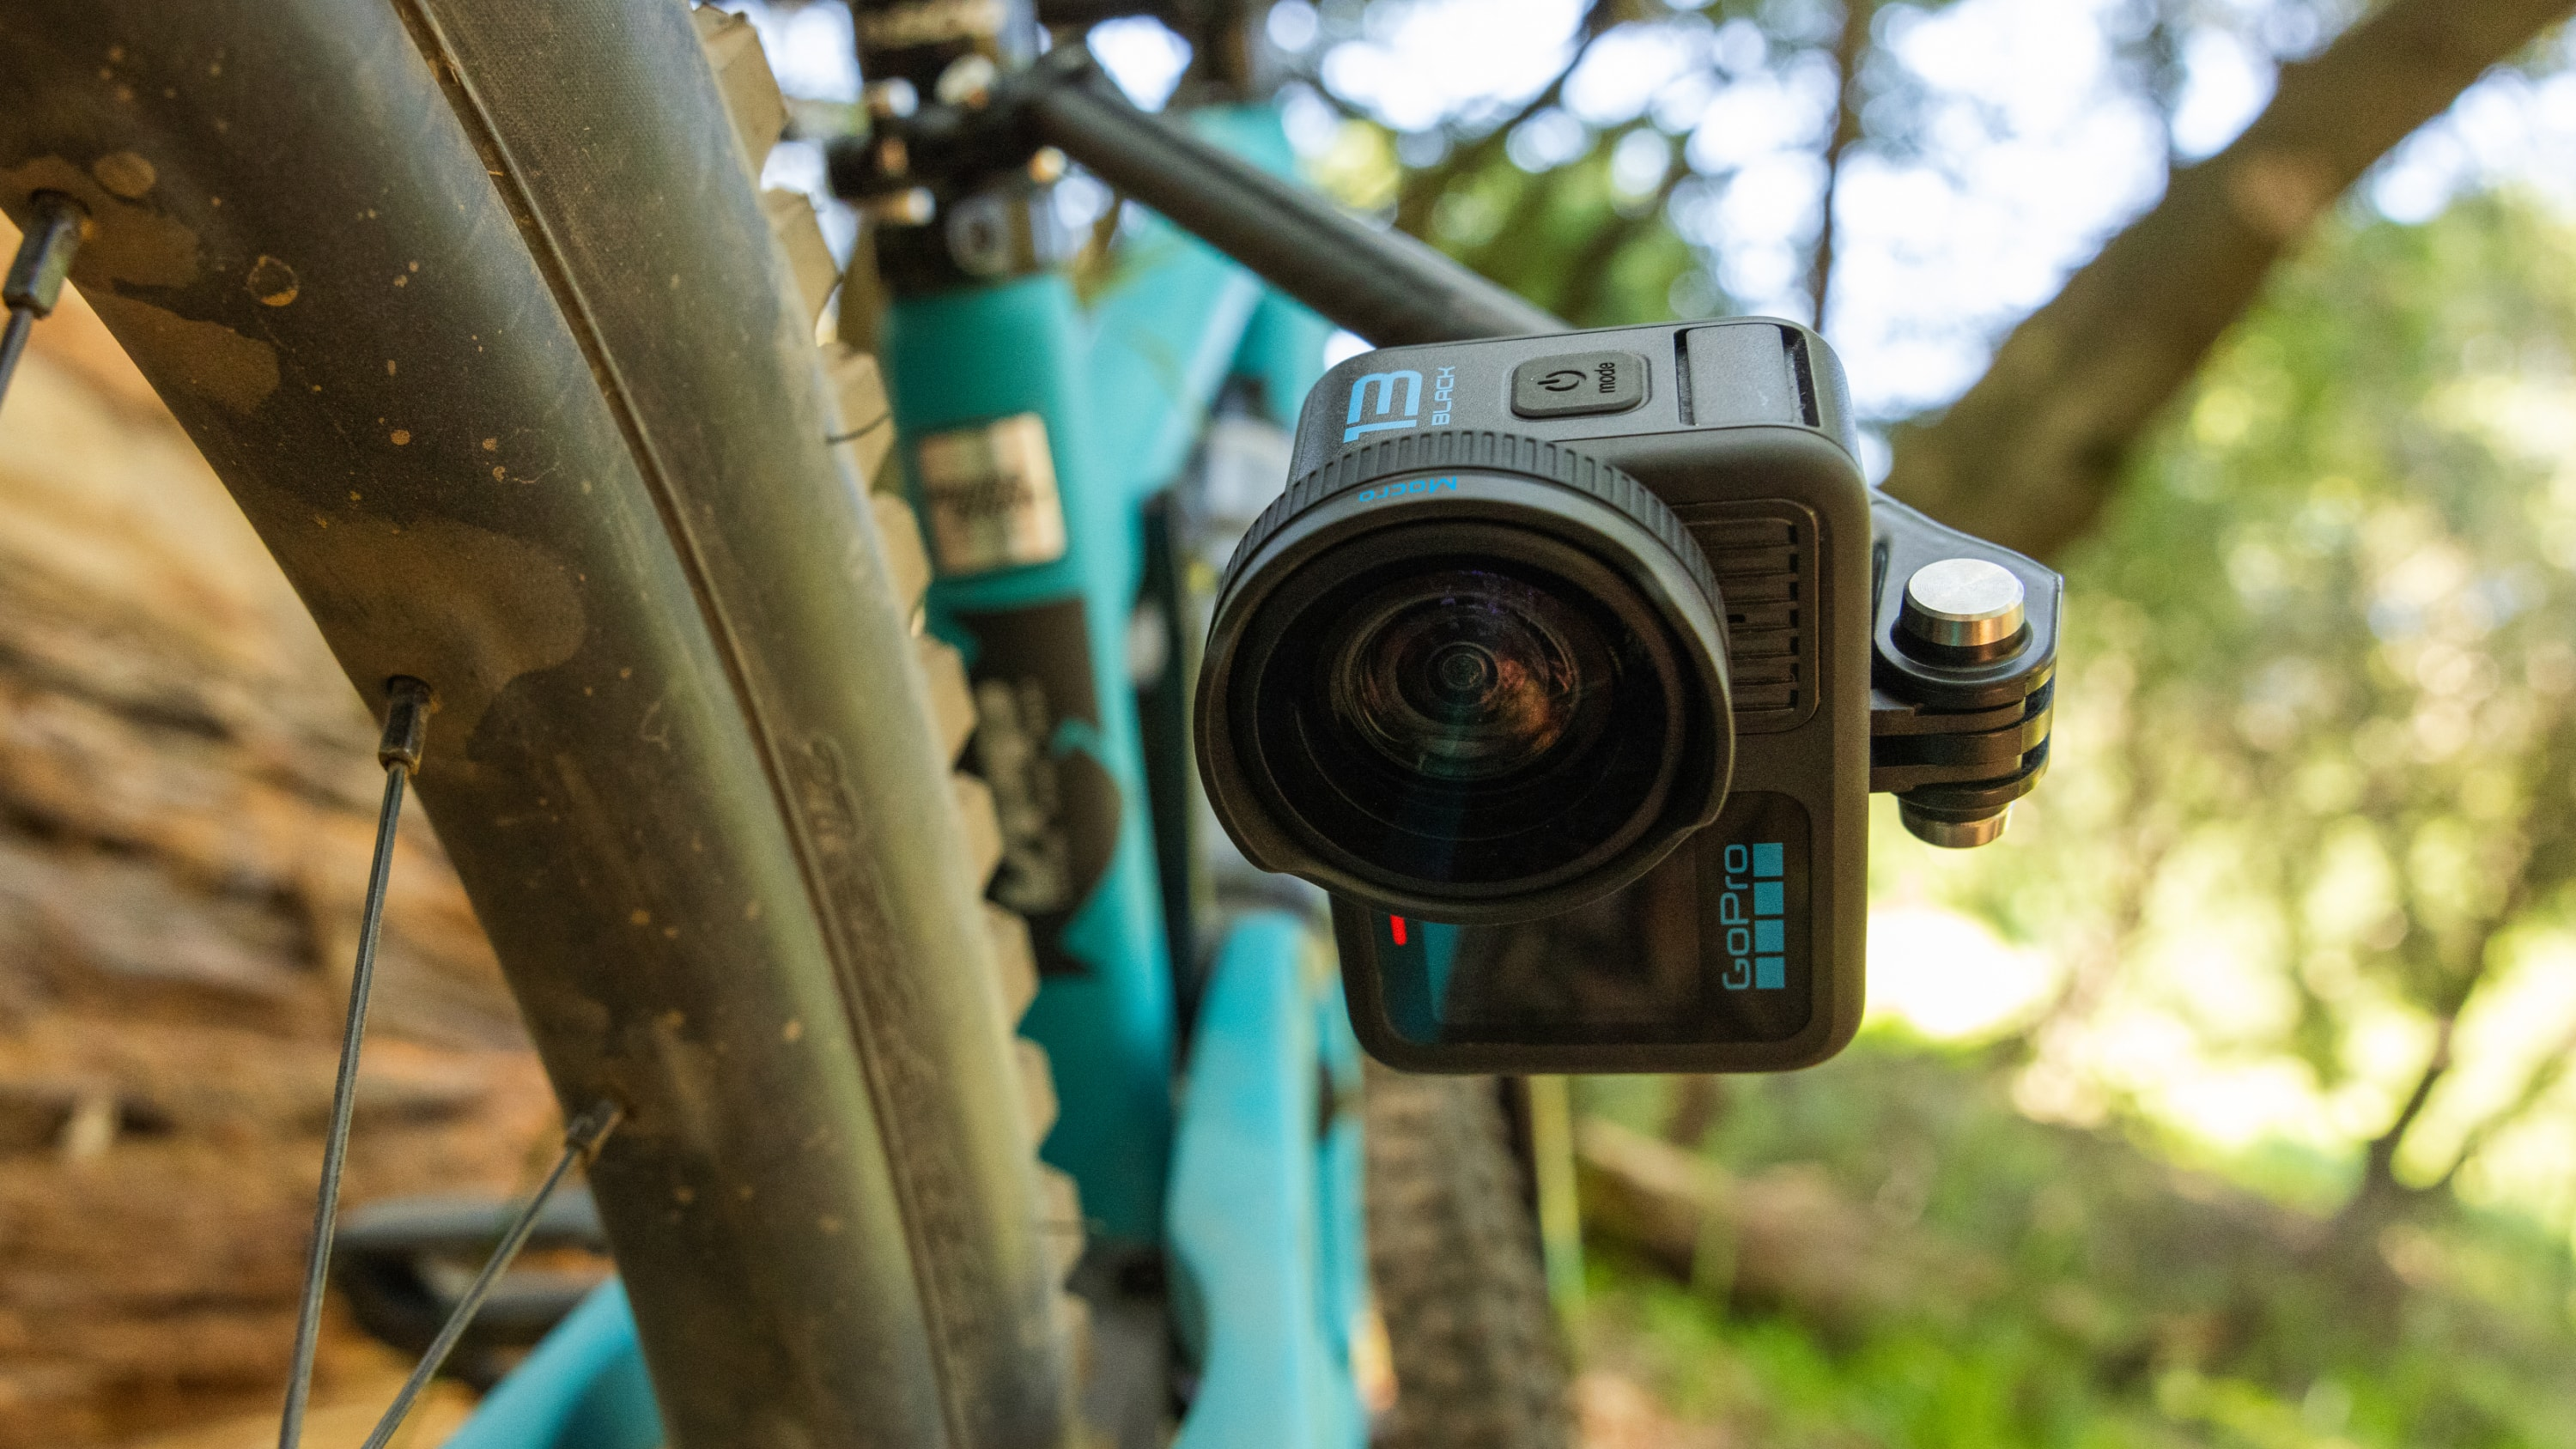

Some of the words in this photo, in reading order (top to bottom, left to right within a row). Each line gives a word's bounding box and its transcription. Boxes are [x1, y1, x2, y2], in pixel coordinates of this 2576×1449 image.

[1343, 370, 1423, 444] 13
[1431, 366, 1456, 426] BLACK
[1594, 362, 1616, 394] mode
[1358, 476, 1458, 502] Macro
[1720, 844, 1751, 990] GoPro
